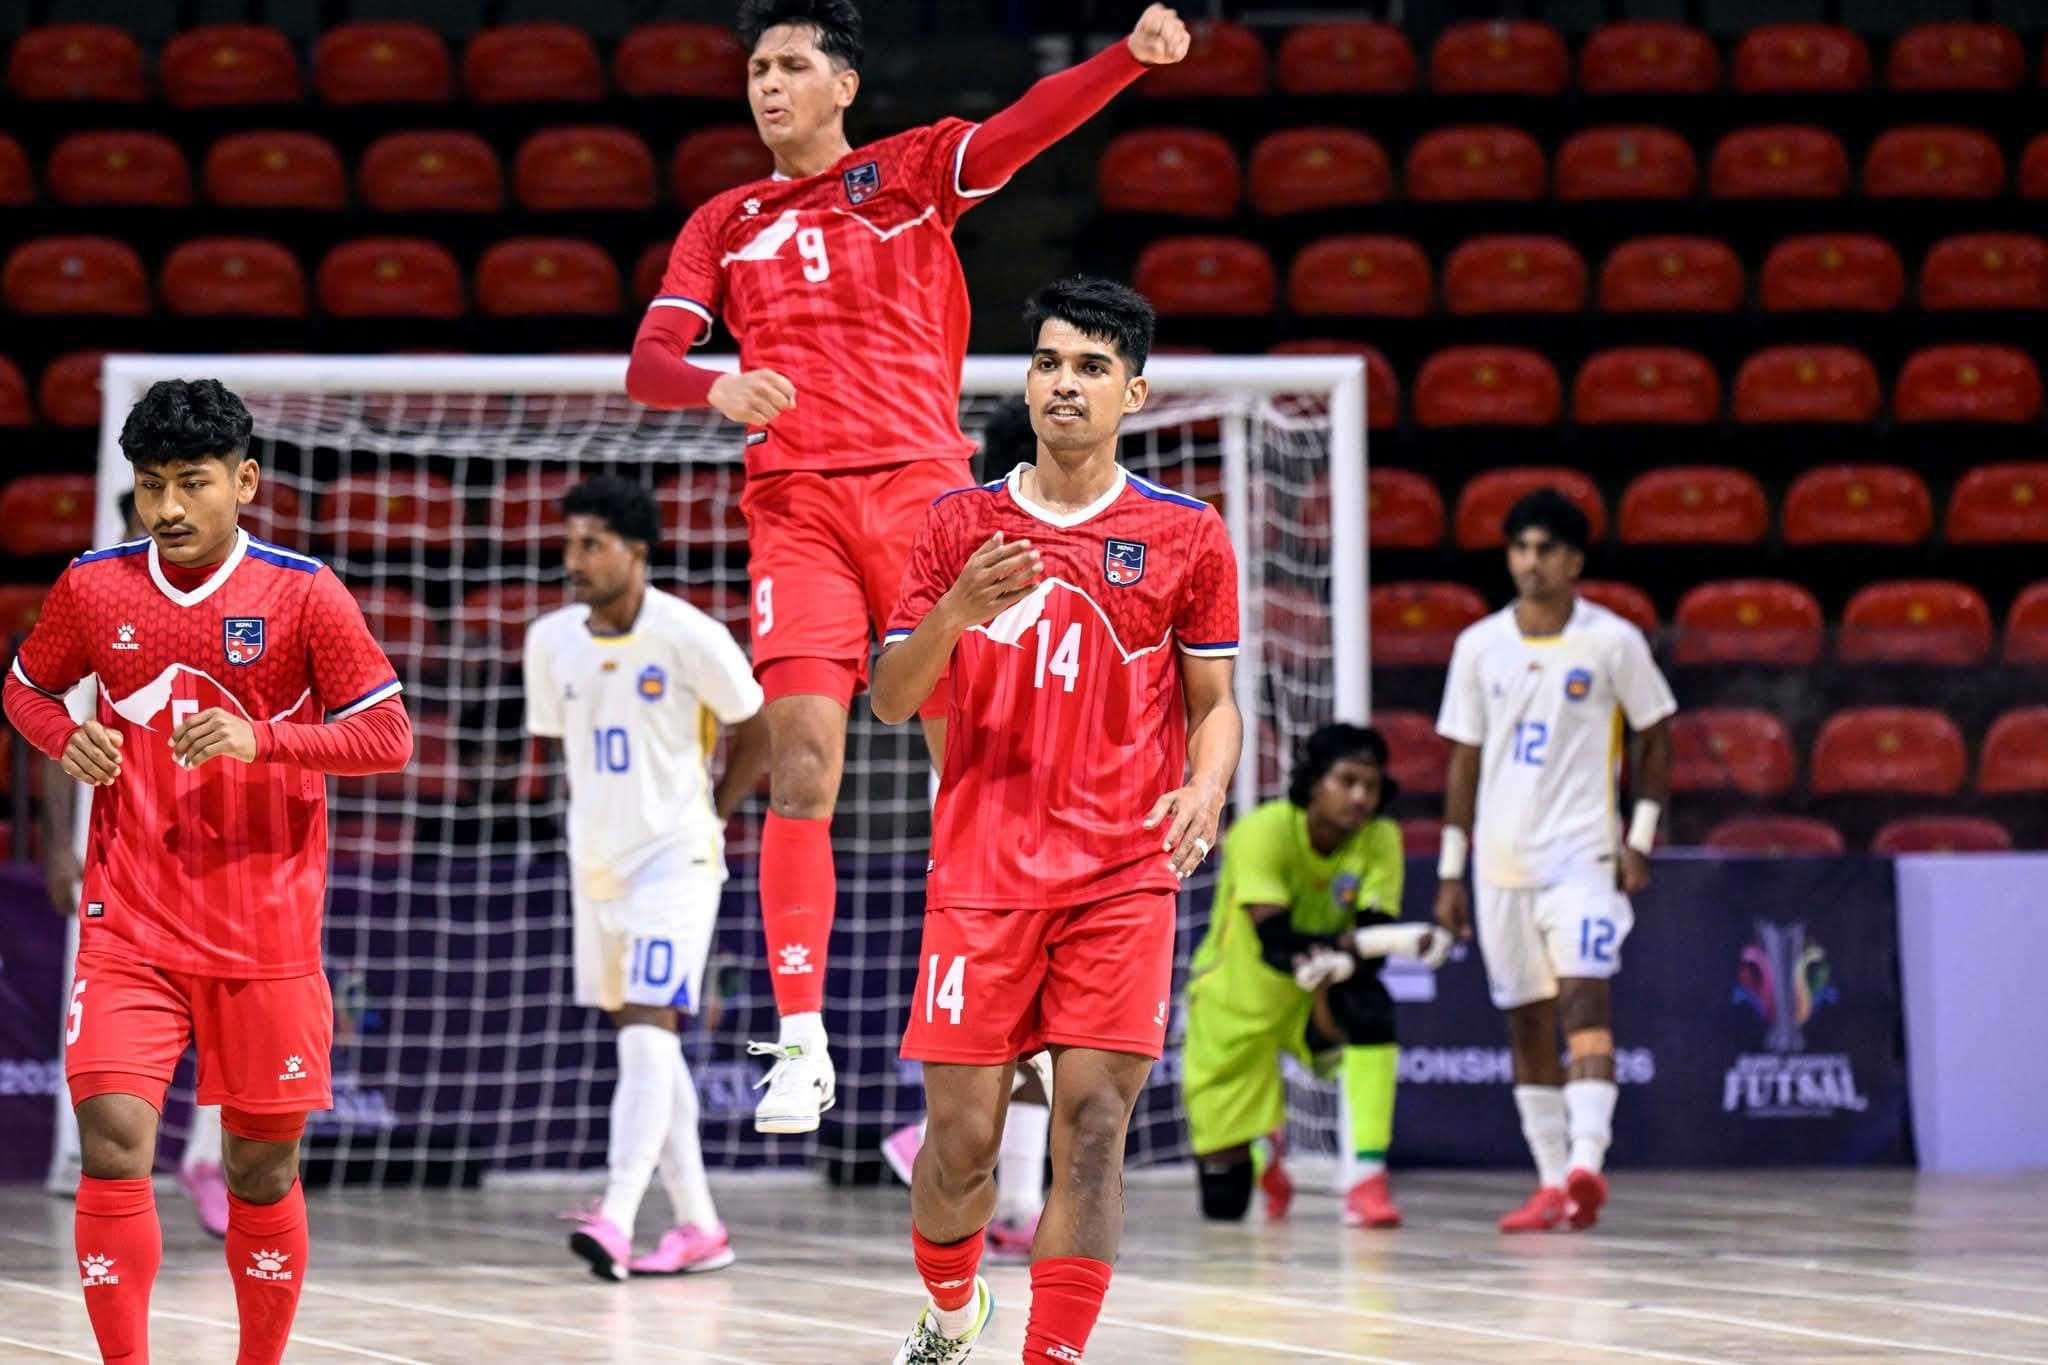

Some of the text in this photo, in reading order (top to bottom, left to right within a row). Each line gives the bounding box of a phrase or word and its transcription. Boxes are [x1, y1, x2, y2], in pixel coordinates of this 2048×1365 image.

[796, 227, 831, 283] 9
[754, 576, 774, 637] 9
[1033, 619, 1082, 692] 14
[594, 727, 630, 774] 10
[1513, 721, 1548, 766] 12
[631, 938, 674, 987] 10
[1579, 916, 1616, 962] 12
[66, 979, 88, 1047] 5
[926, 953, 967, 1025] 14
[278, 1071, 308, 1081] KELME
[246, 1266, 293, 1281] KELME
